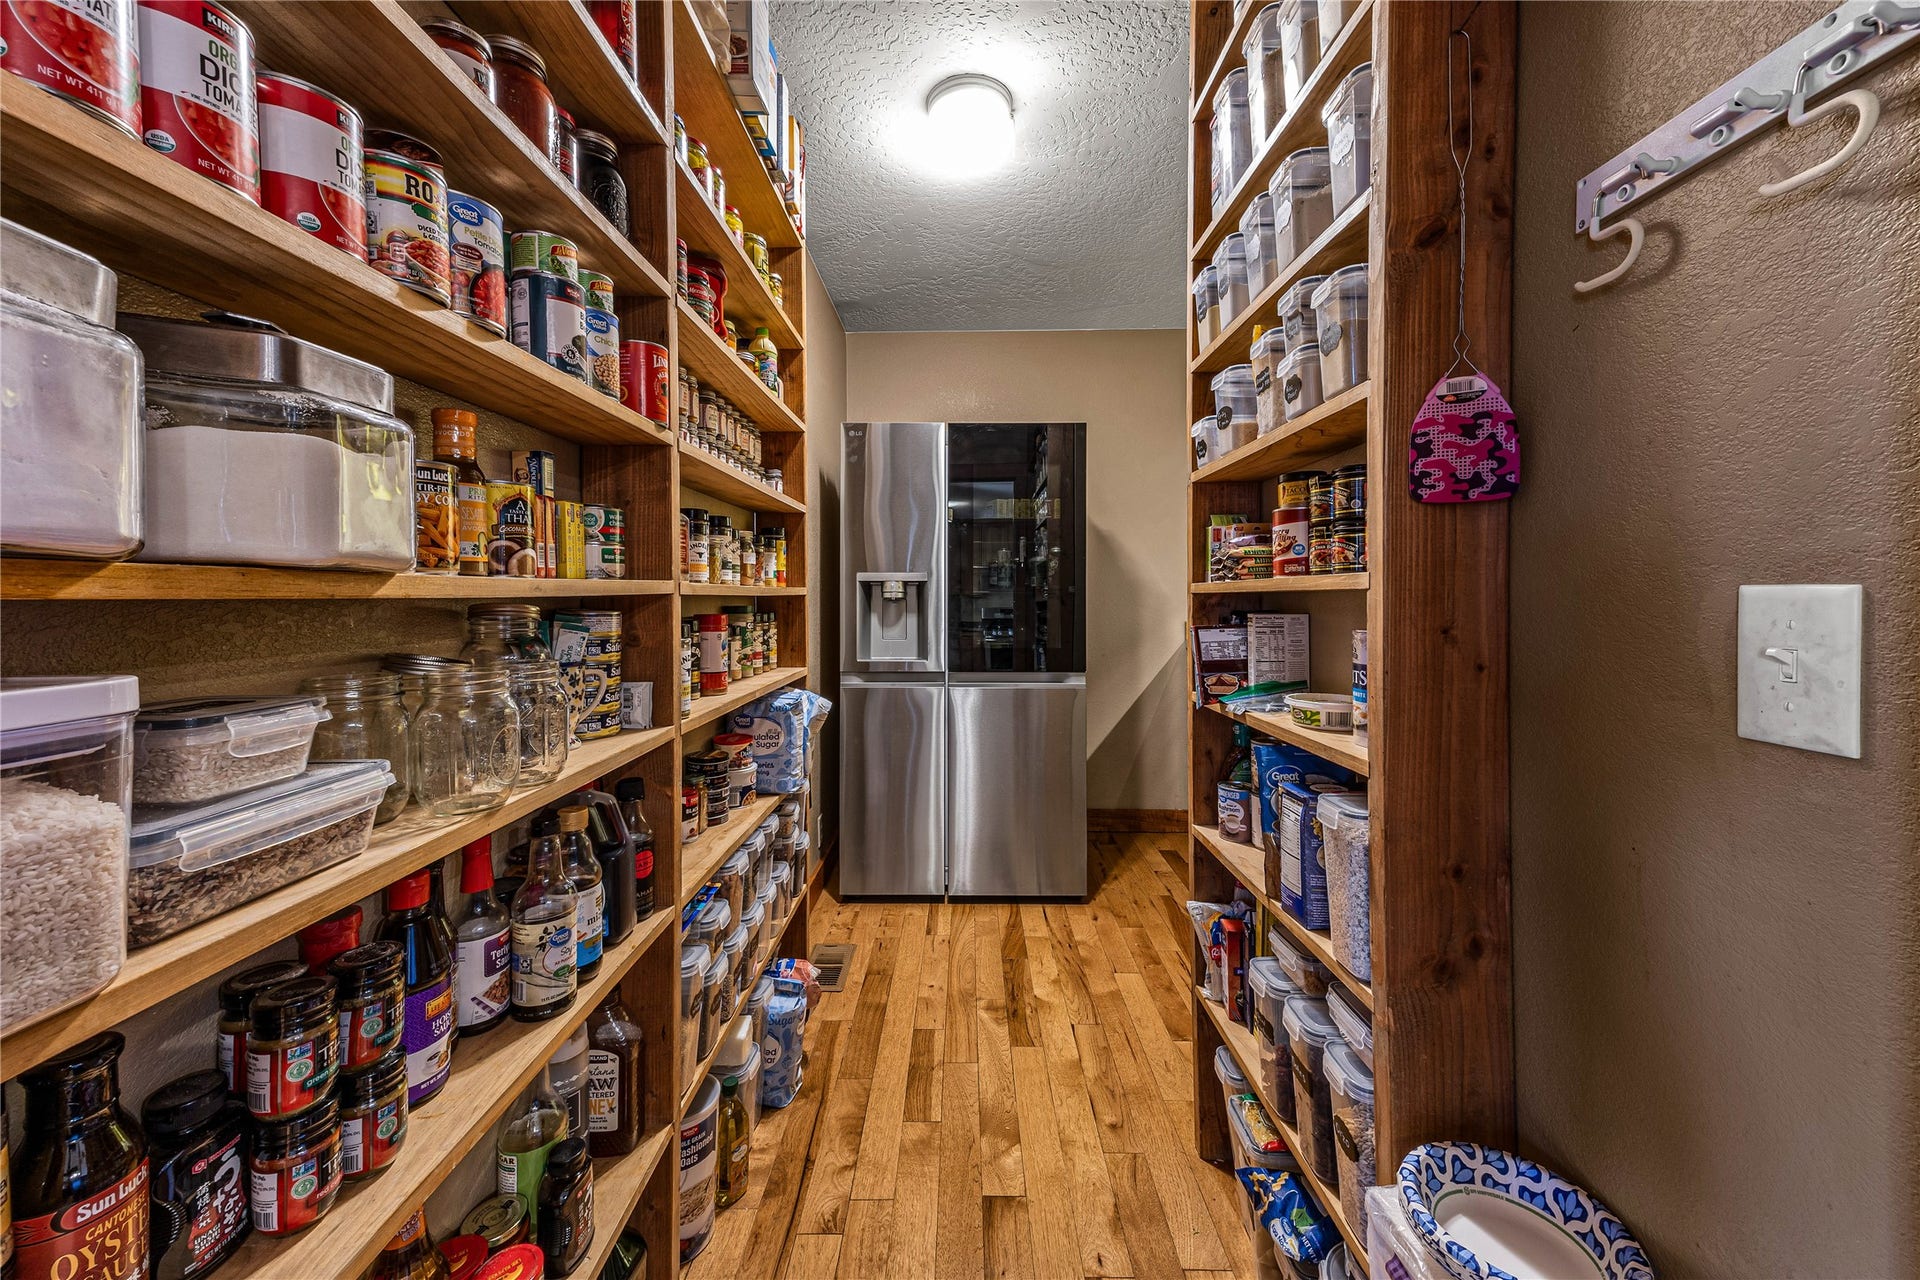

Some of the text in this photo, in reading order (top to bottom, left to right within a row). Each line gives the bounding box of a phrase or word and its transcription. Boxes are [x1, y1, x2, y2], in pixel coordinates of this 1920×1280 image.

[37, 63, 62, 80] NET
[65, 75, 84, 90] WT
[150, 132, 170, 143] USDA
[197, 157, 216, 171] NET
[217, 165, 231, 178] WT
[452, 204, 478, 219] Great
[587, 316, 607, 328] Great
[516, 500, 525, 510] A
[753, 731, 780, 741] ulated
[755, 741, 780, 750] Sugar
[1271, 771, 1301, 782] Great
[560, 946, 573, 957] Soy
[681, 1153, 699, 1168] Oats
[76, 1164, 147, 1224] Sun Luck
[85, 1188, 147, 1241] CANTONESE
